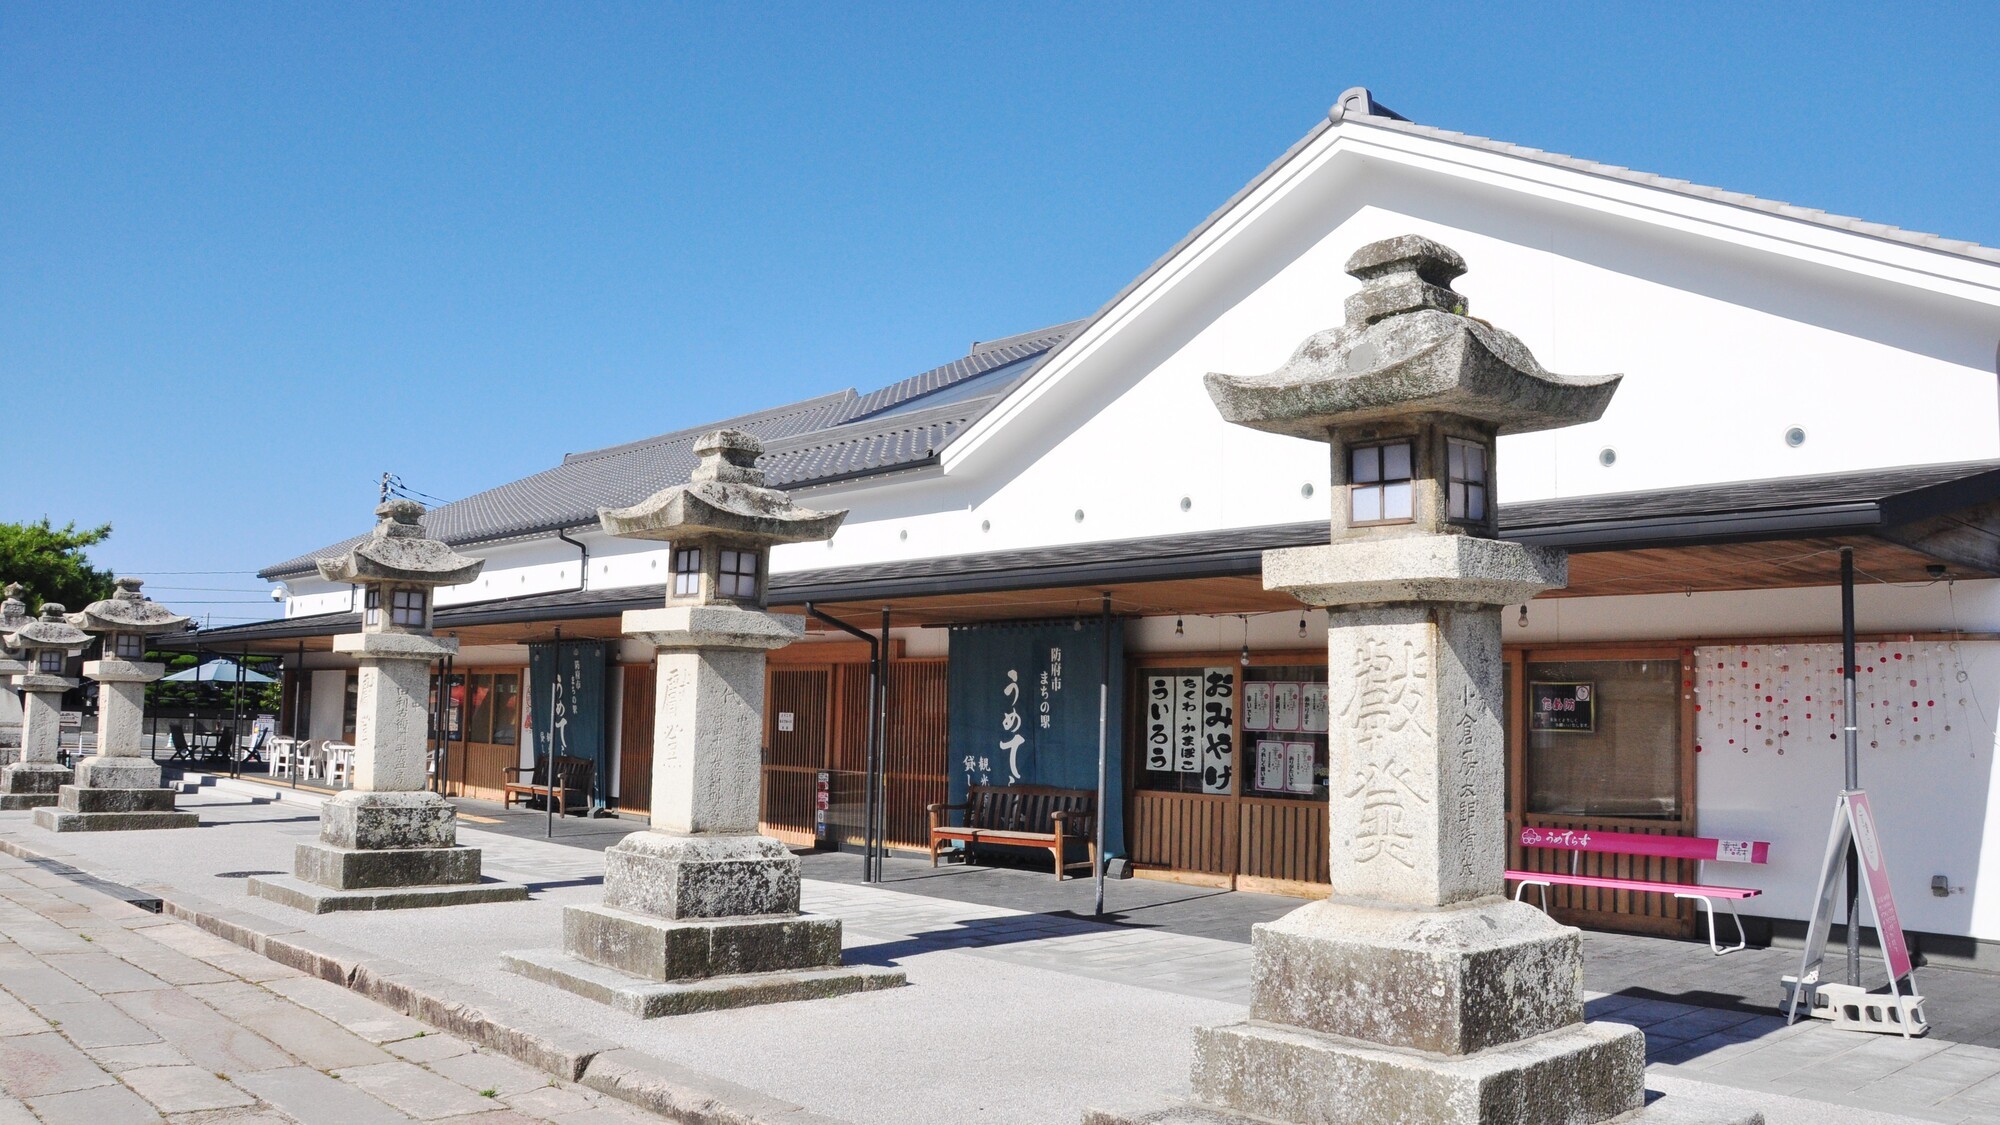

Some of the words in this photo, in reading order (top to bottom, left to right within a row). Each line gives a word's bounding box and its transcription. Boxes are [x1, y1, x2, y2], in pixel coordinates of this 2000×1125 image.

[1051, 648, 1061, 691] 防府市
[1040, 671, 1050, 728] まちの駅
[1150, 679, 1169, 768] ういろう
[1205, 671, 1233, 790] おみやげ
[1545, 831, 1591, 847] うめてらす
